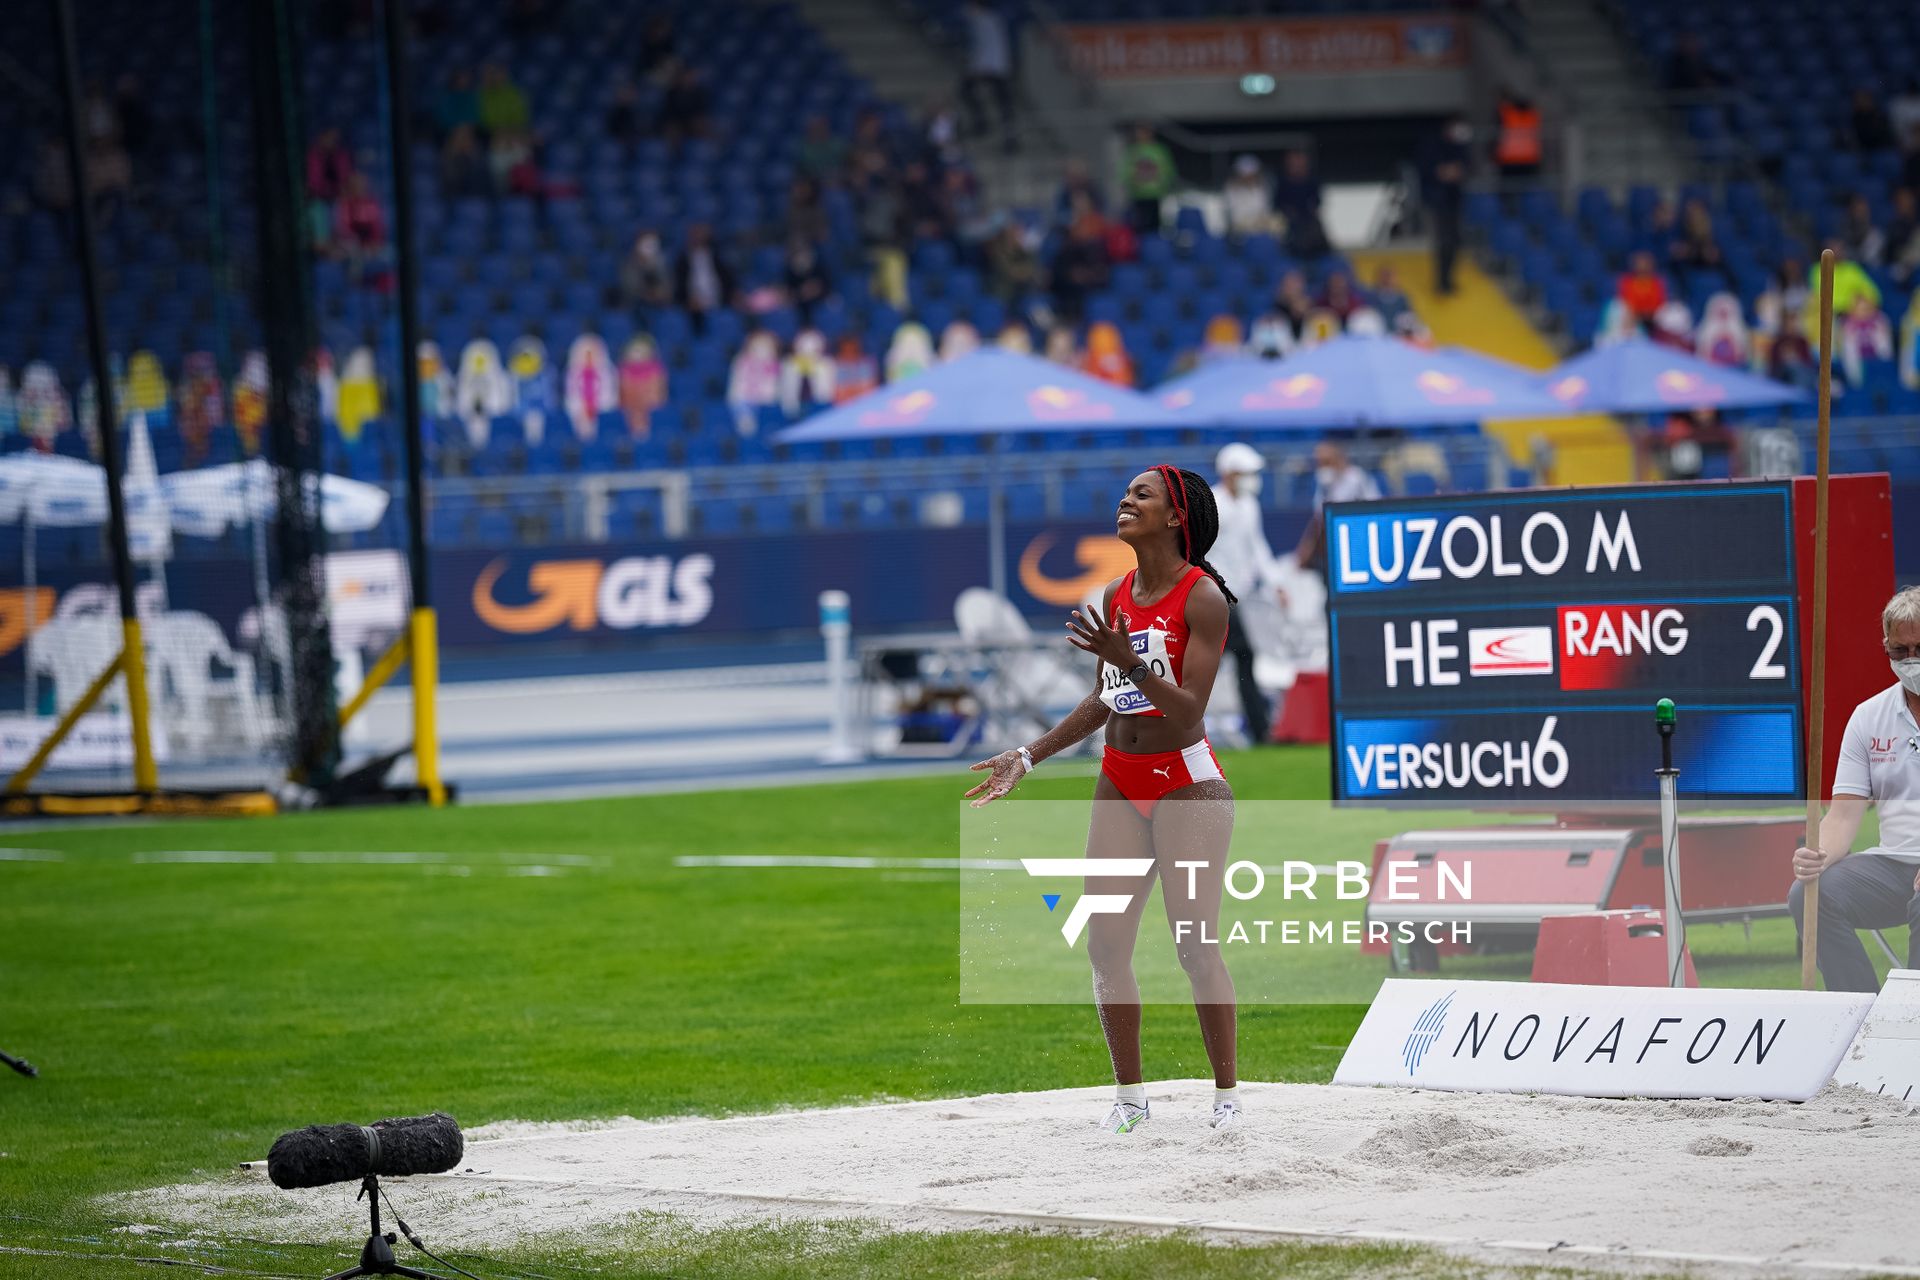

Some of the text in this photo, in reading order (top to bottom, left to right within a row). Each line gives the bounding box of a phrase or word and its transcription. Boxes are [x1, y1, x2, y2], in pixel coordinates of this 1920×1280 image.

[1338, 510, 1642, 584] LUZOLO M
[598, 553, 714, 629] GLS
[1383, 605, 1786, 687] HE RANG 2
[1452, 1012, 1786, 1066] NOVAFON
